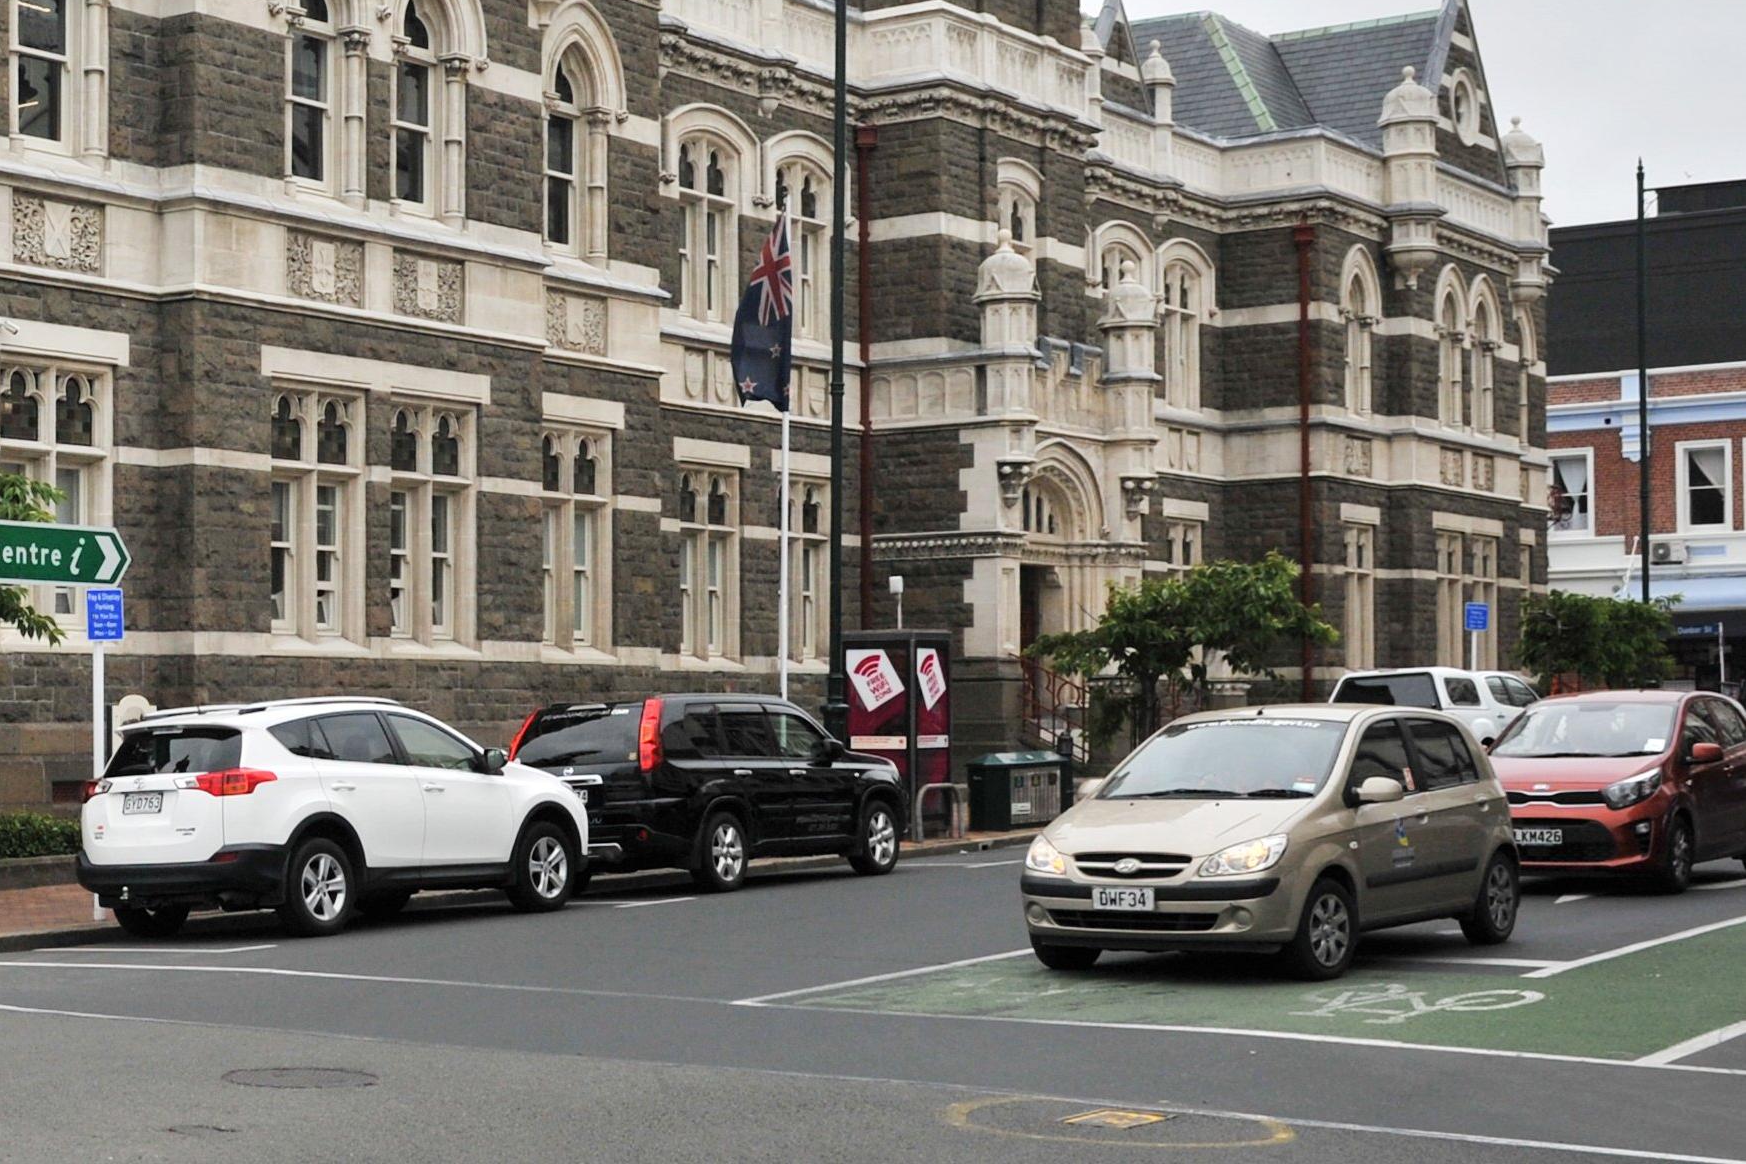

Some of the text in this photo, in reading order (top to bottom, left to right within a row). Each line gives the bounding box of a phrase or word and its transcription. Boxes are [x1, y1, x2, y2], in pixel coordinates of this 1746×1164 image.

[95, 603, 114, 611] Parking
[867, 672, 885, 687] FREE
[125, 797, 160, 810] GYD763
[1513, 830, 1561, 842] LKM426
[1099, 891, 1146, 907] DWF34
